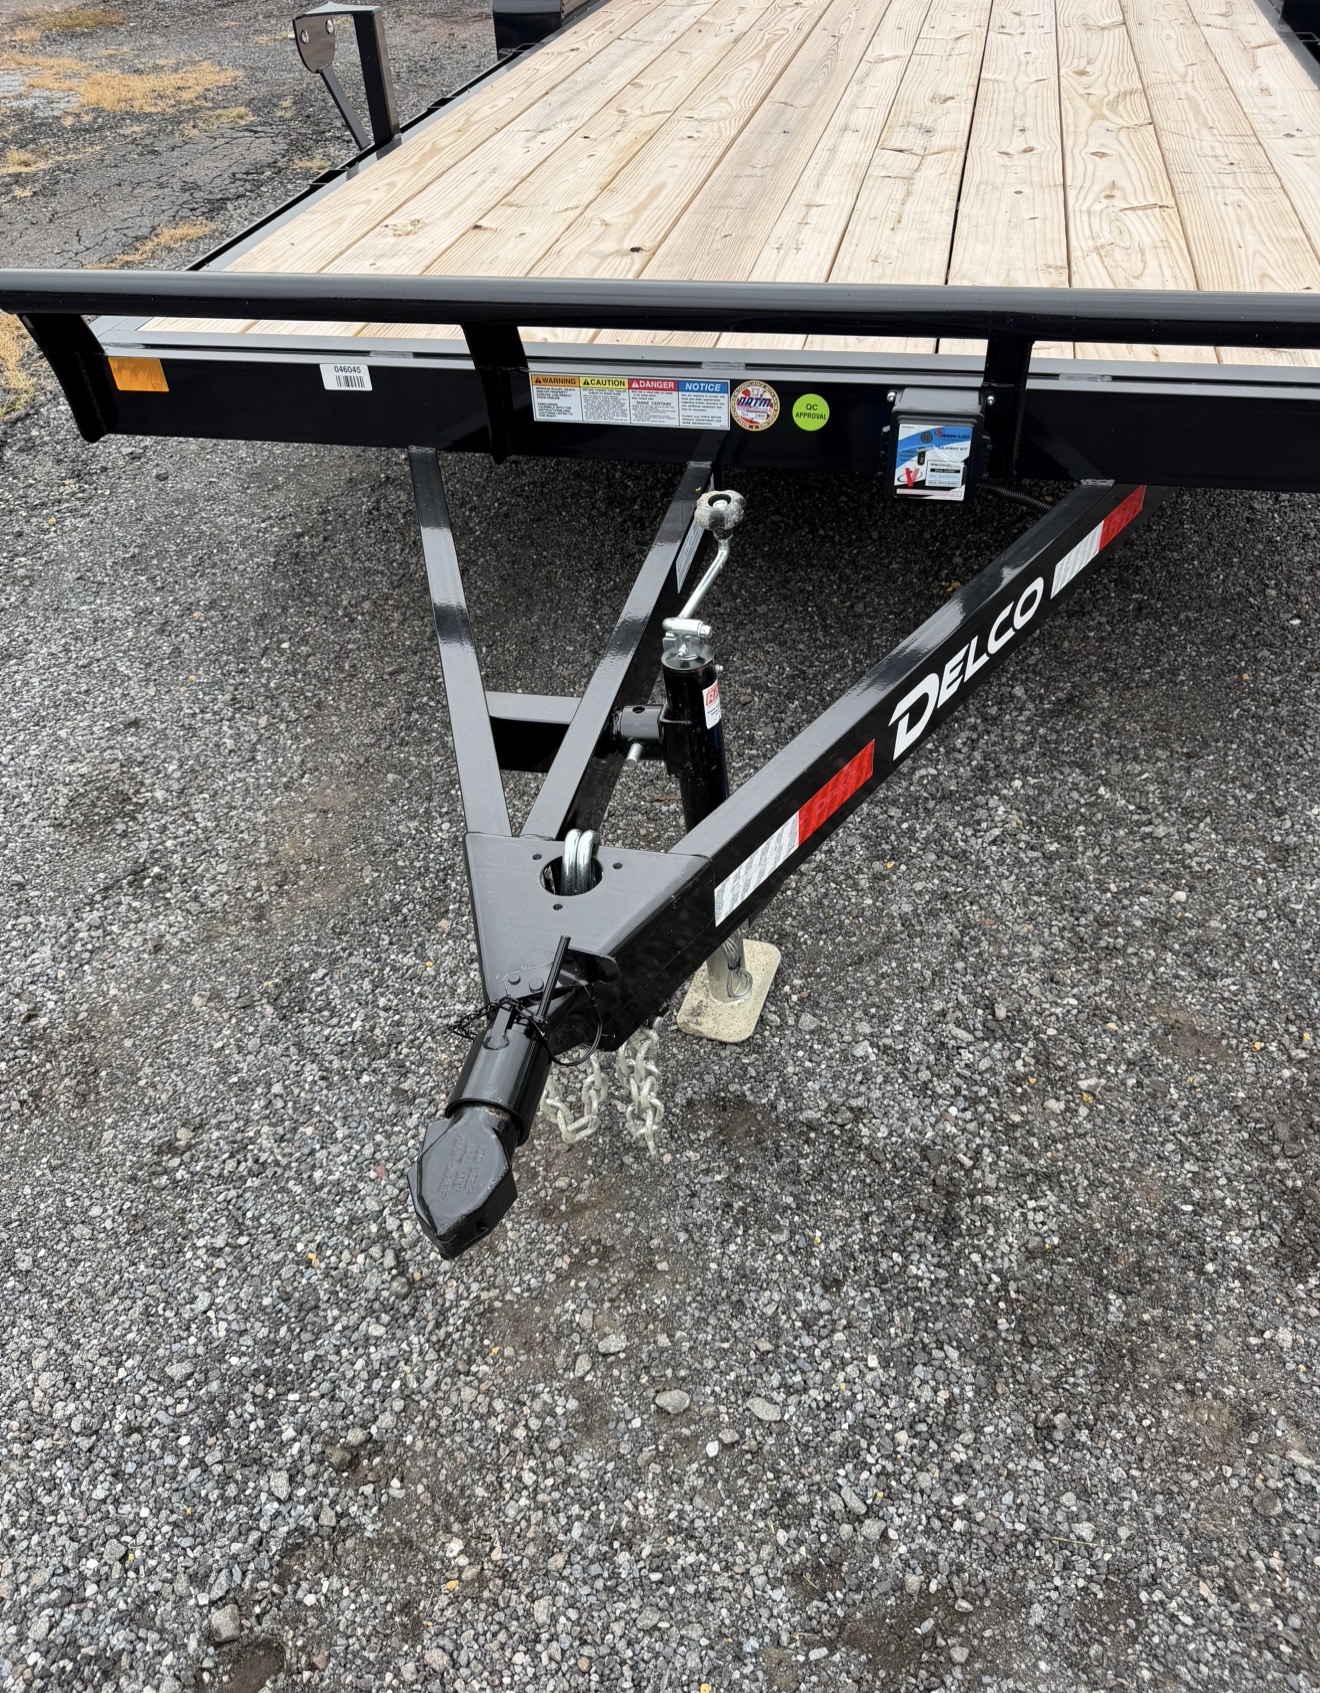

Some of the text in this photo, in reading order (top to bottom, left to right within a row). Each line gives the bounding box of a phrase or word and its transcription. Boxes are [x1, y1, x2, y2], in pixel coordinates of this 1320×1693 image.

[333, 365, 362, 374] 046045
[541, 376, 576, 385] WARNING
[590, 378, 626, 387] CAUTION
[639, 380, 675, 389] DANGER
[685, 382, 721, 392] NOTICE
[805, 403, 819, 411] QC
[795, 411, 827, 420] APPROVAL
[888, 576, 1044, 761] DELCO
